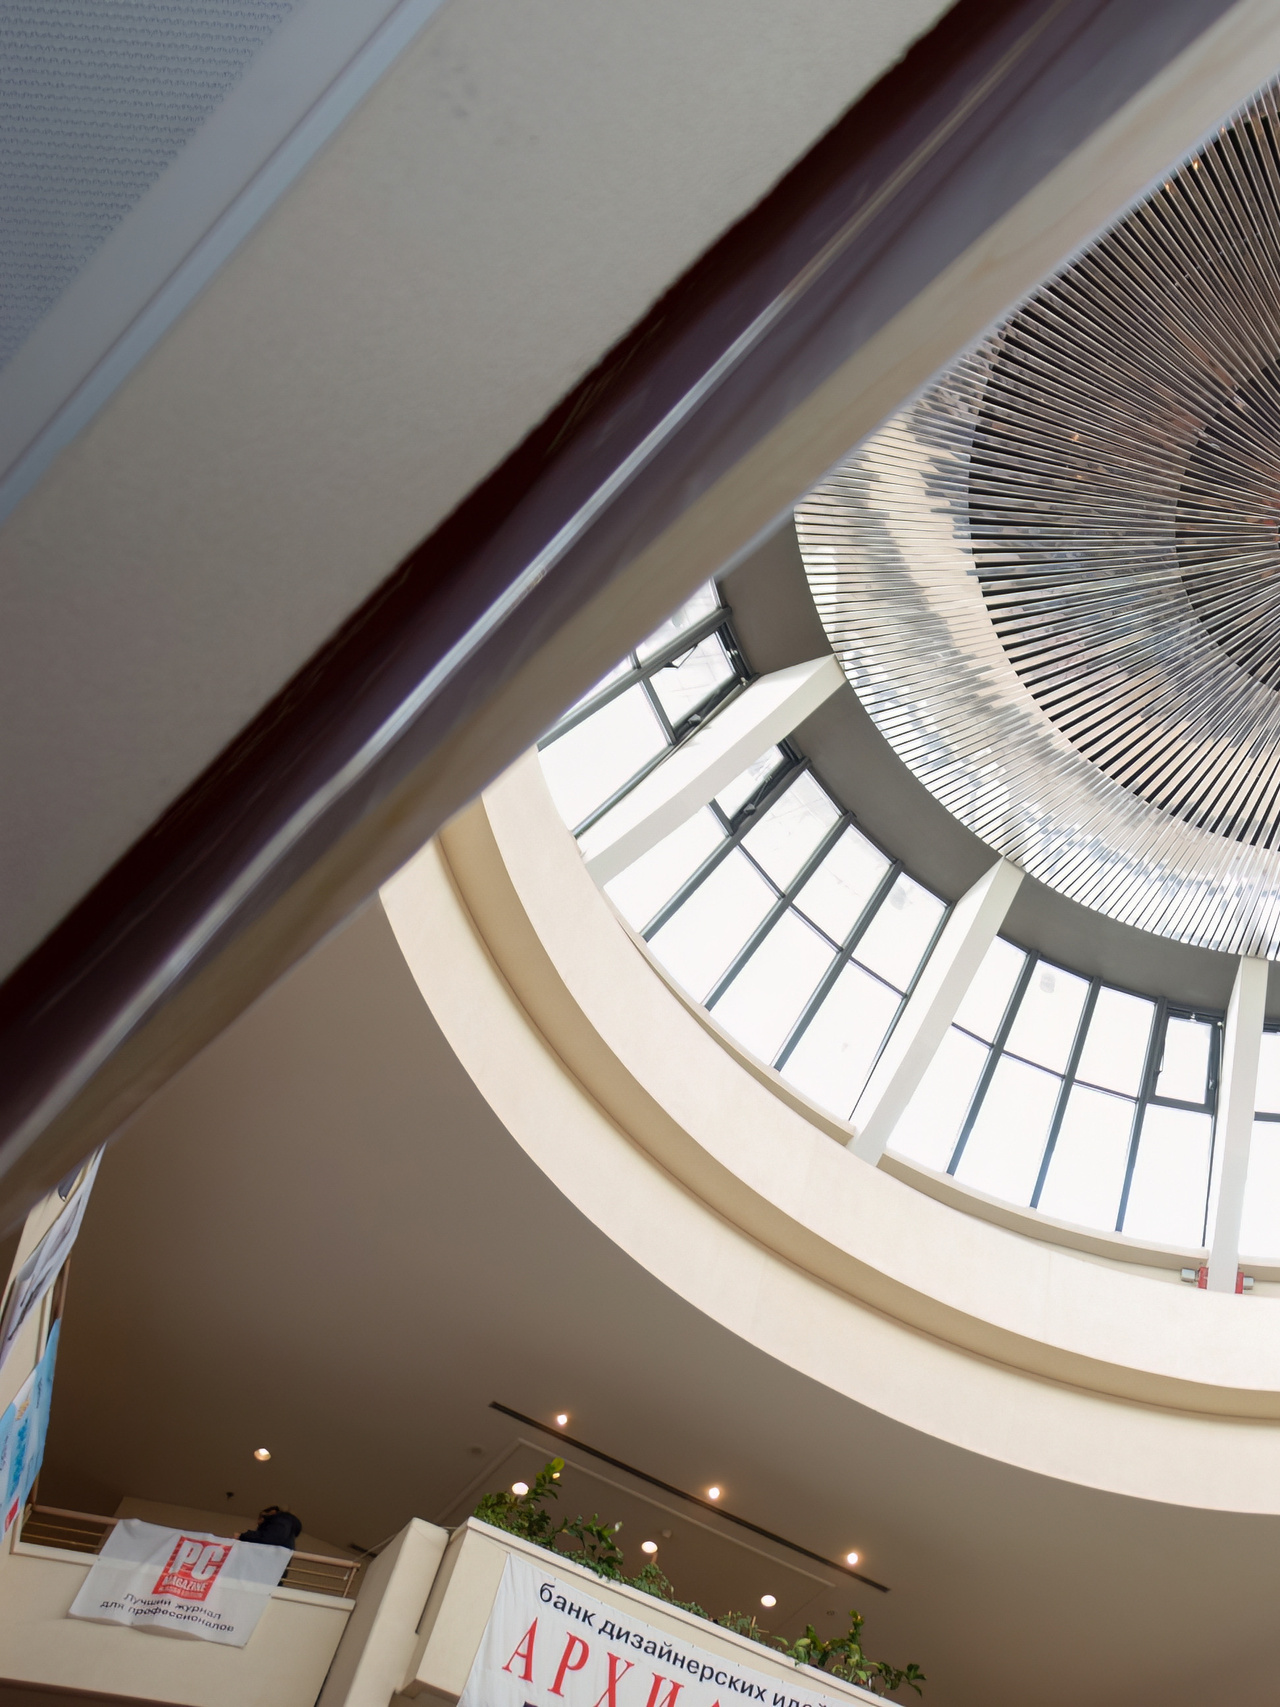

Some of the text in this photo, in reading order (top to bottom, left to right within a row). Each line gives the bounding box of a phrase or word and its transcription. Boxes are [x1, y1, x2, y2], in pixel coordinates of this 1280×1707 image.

[168, 1539, 226, 1582] PC
[163, 1574, 209, 1592] MAGAZINE
[100, 1600, 235, 1633] для профессионалов
[175, 1603, 222, 1620] журнал
[539, 1582, 597, 1628] банк
[598, 1619, 768, 1702] дизайнерских
[502, 1617, 721, 1707] АРХИ
